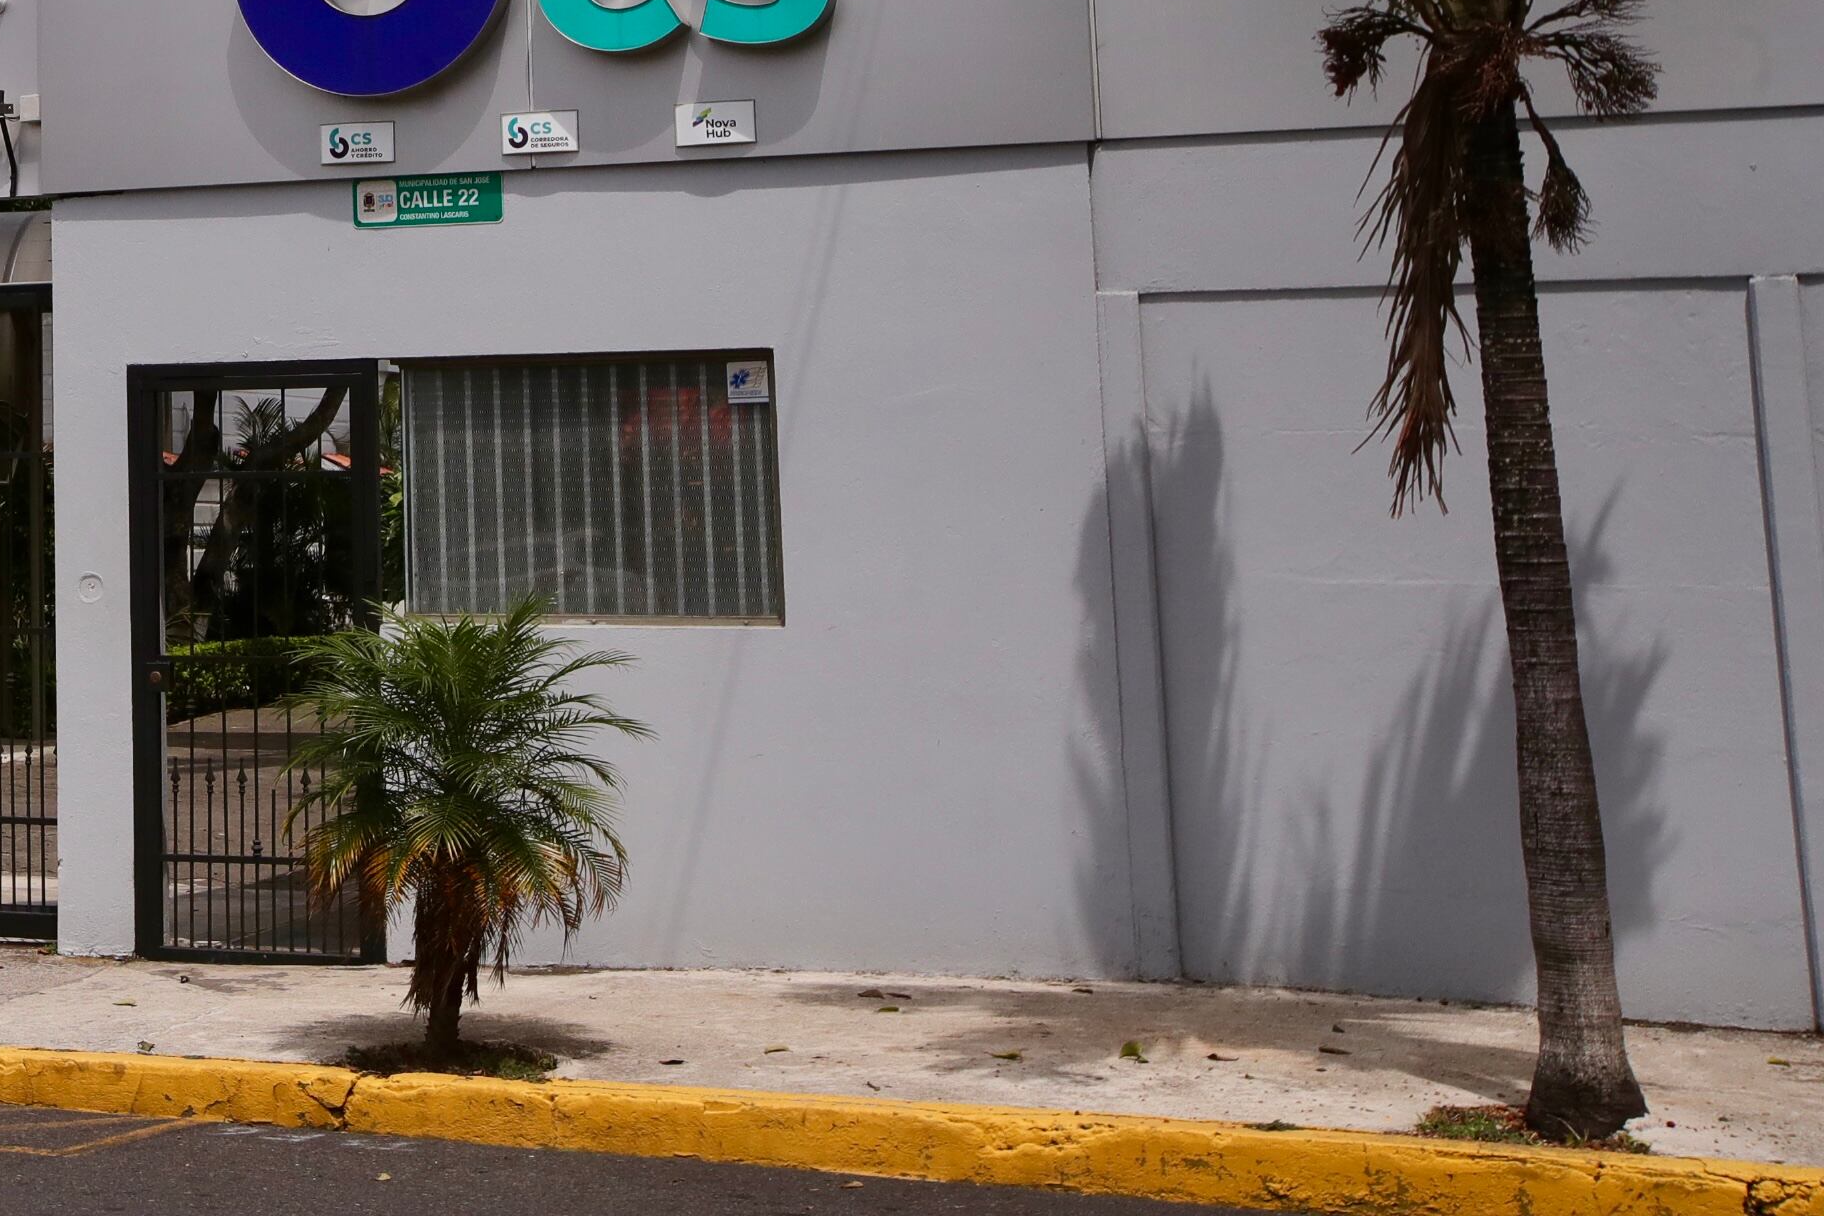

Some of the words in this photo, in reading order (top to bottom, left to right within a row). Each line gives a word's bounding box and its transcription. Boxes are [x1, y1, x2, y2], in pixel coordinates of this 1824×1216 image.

[530, 121, 552, 134] CS
[705, 119, 737, 128] Nova
[351, 132, 372, 145] CS
[706, 128, 731, 138] Hub
[399, 177, 448, 187] MUNICIPALIDAD
[449, 177, 458, 185] DE
[459, 176, 473, 185] SAN
[399, 189, 453, 208] CALLE
[458, 188, 480, 206] 22
[399, 212, 440, 221] CONSTANTINO
